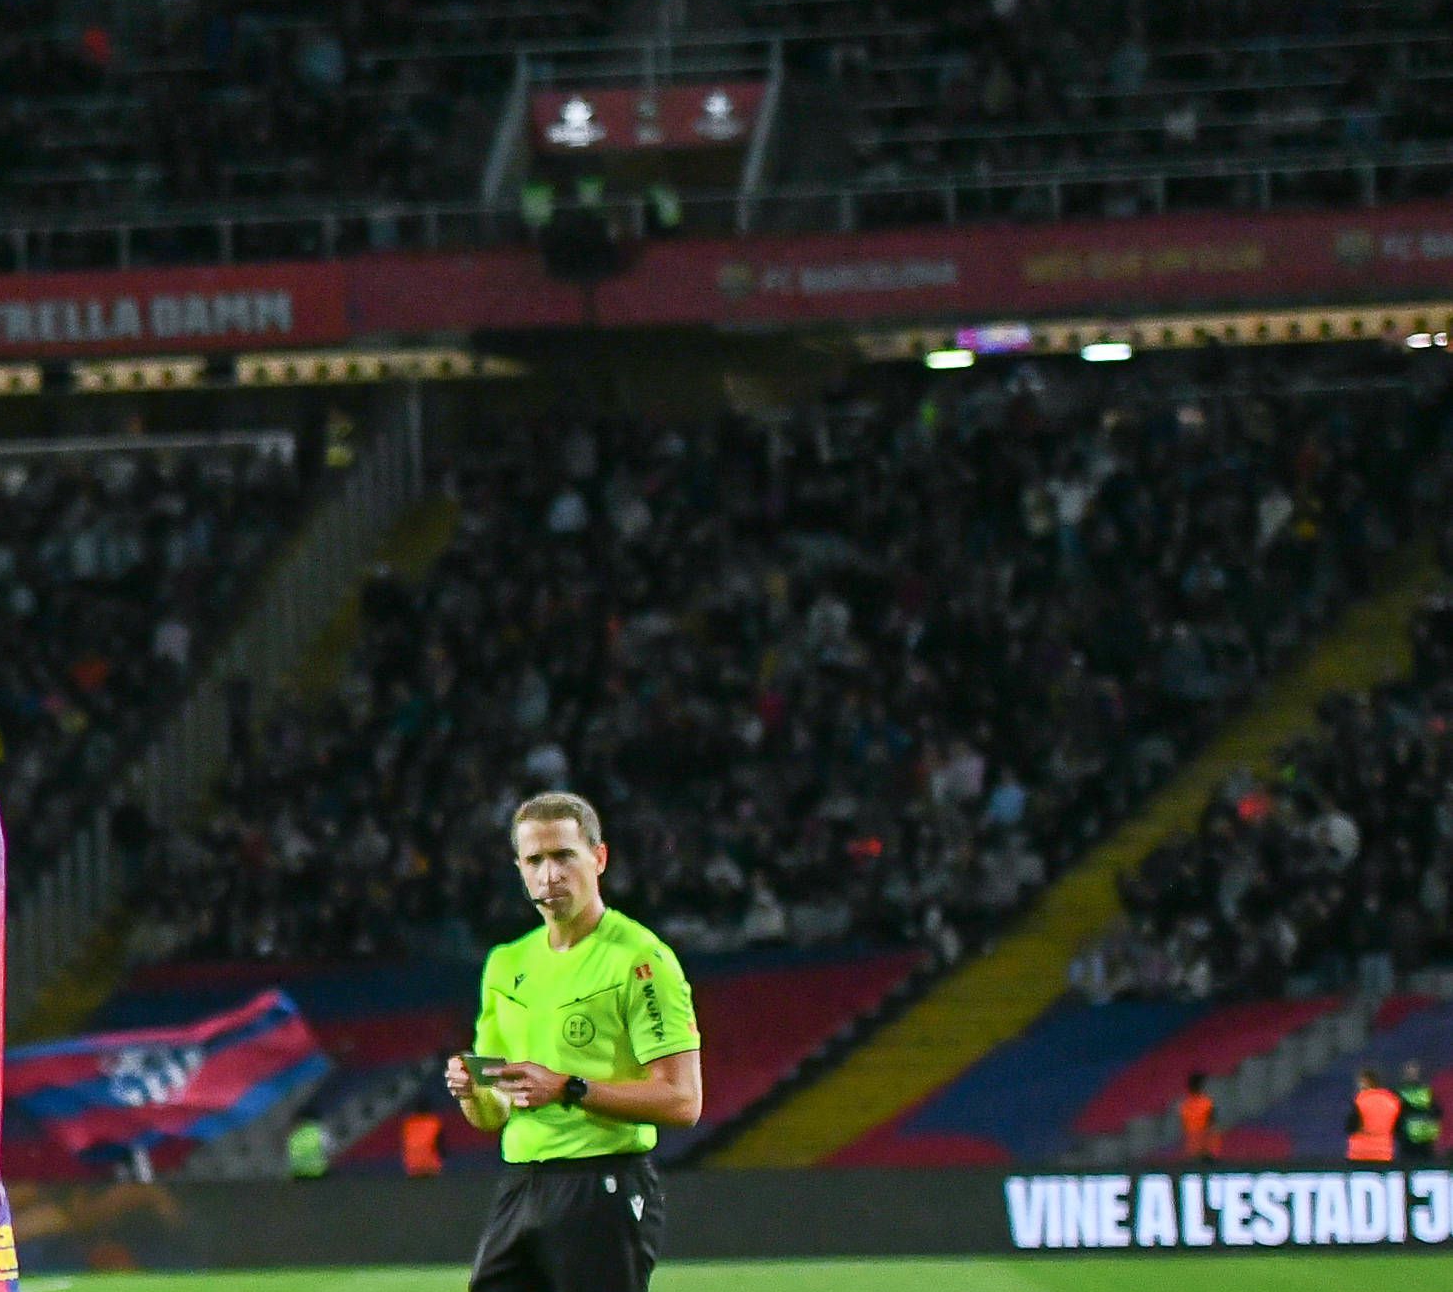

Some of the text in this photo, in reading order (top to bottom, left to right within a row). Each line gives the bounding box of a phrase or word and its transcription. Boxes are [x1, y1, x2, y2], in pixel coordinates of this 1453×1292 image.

[150, 290, 293, 338] DAMM
[1006, 1175, 1132, 1248] VINE
[1137, 1174, 1178, 1247] A
[1183, 1171, 1407, 1246] L'ESTADI
